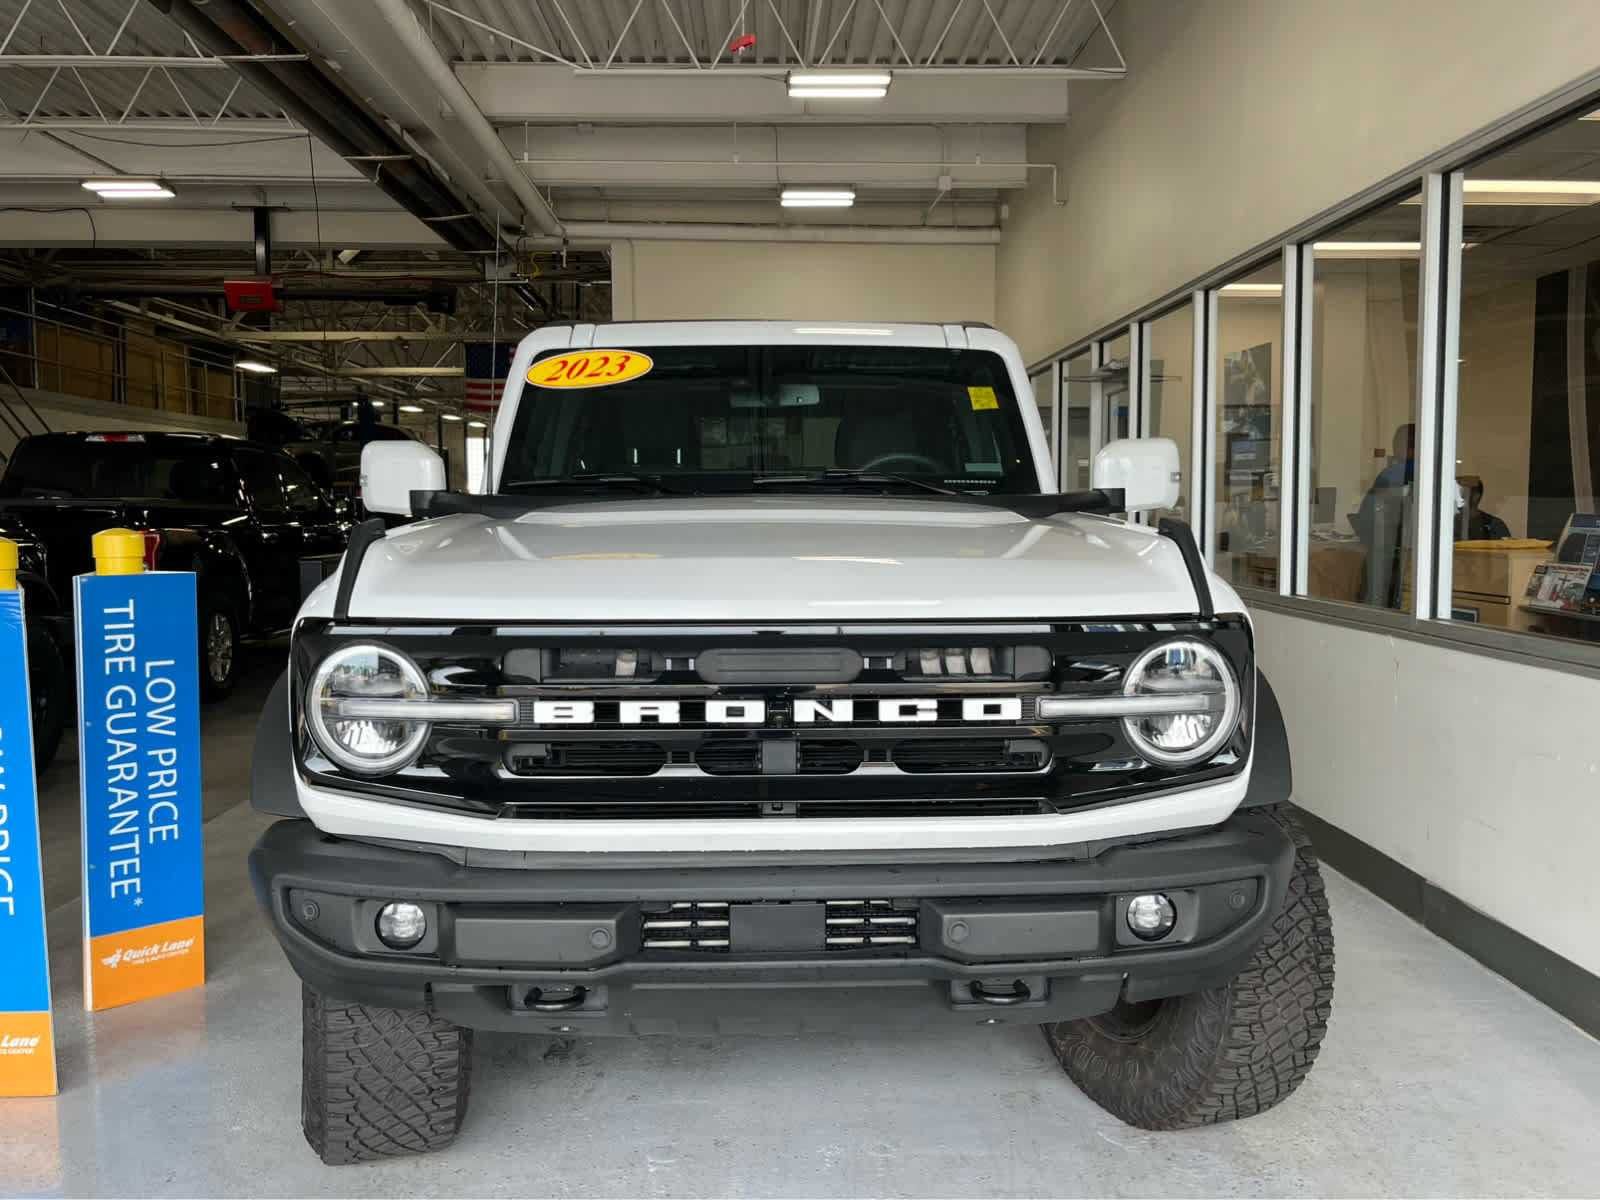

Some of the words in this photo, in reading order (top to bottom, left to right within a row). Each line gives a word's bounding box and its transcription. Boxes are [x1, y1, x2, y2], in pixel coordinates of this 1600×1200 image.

[544, 355, 631, 382] 2023
[103, 599, 136, 675] TIRE
[145, 659, 177, 736] LOW
[533, 699, 1022, 724] BRONCO
[147, 747, 179, 844] PRICE
[123, 945, 159, 961] Quick
[161, 937, 194, 952] Lane
[1, 1035, 39, 1047] Lane
